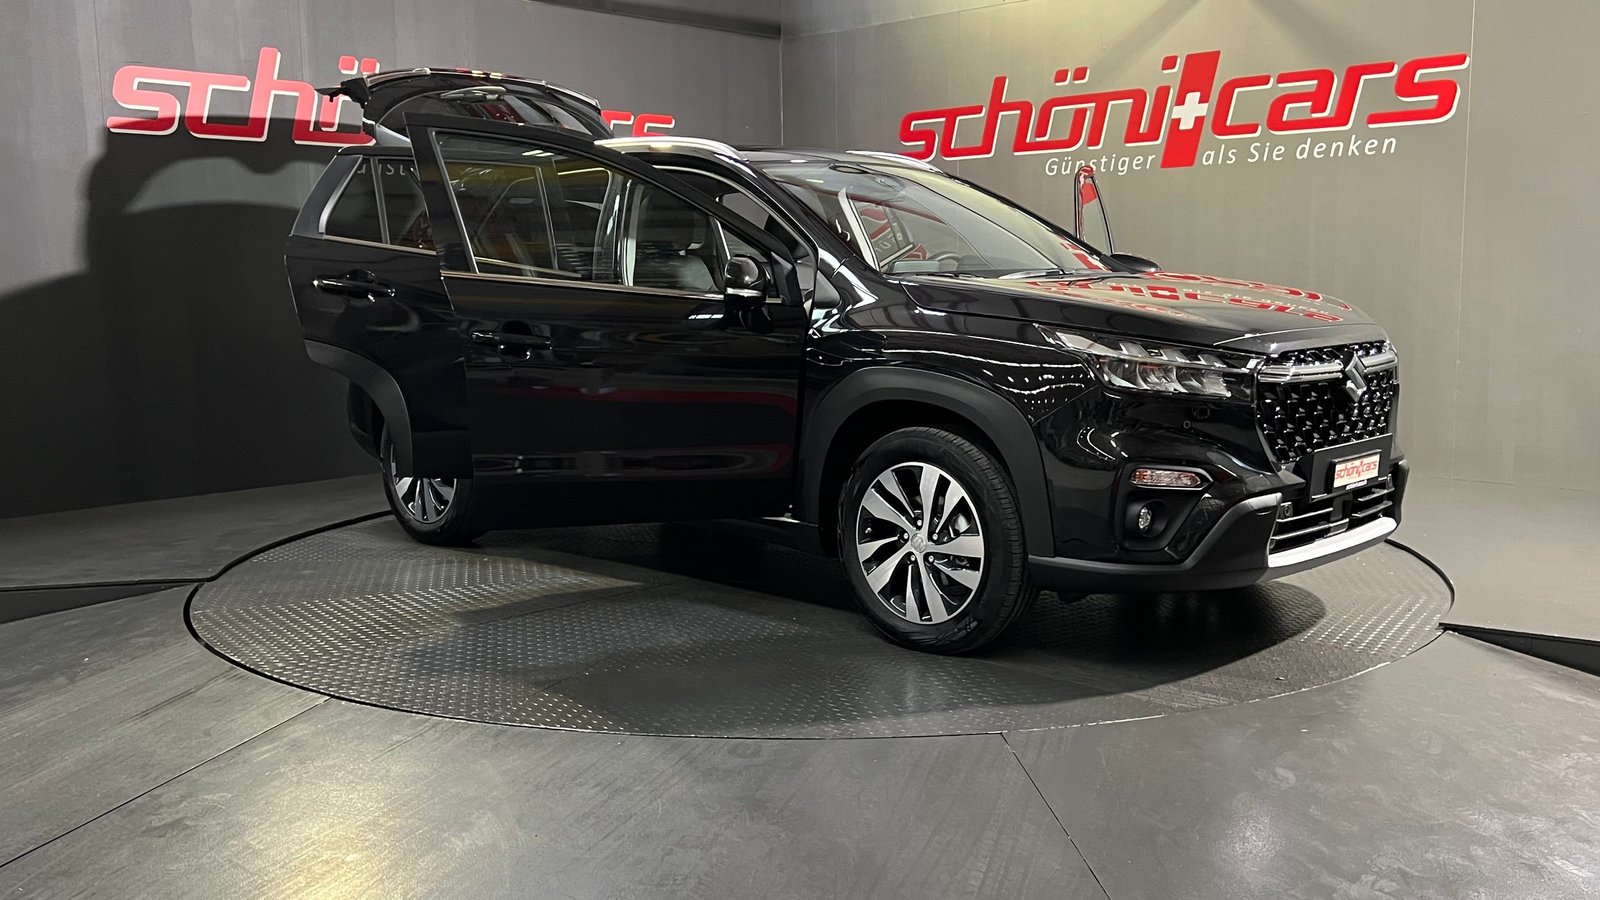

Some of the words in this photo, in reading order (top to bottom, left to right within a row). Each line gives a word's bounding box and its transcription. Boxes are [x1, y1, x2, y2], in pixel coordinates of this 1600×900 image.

[1045, 153, 1156, 177] Günstiger
[1201, 144, 1237, 166] als
[1246, 142, 1284, 163] Sie
[1295, 135, 1397, 160] denken
